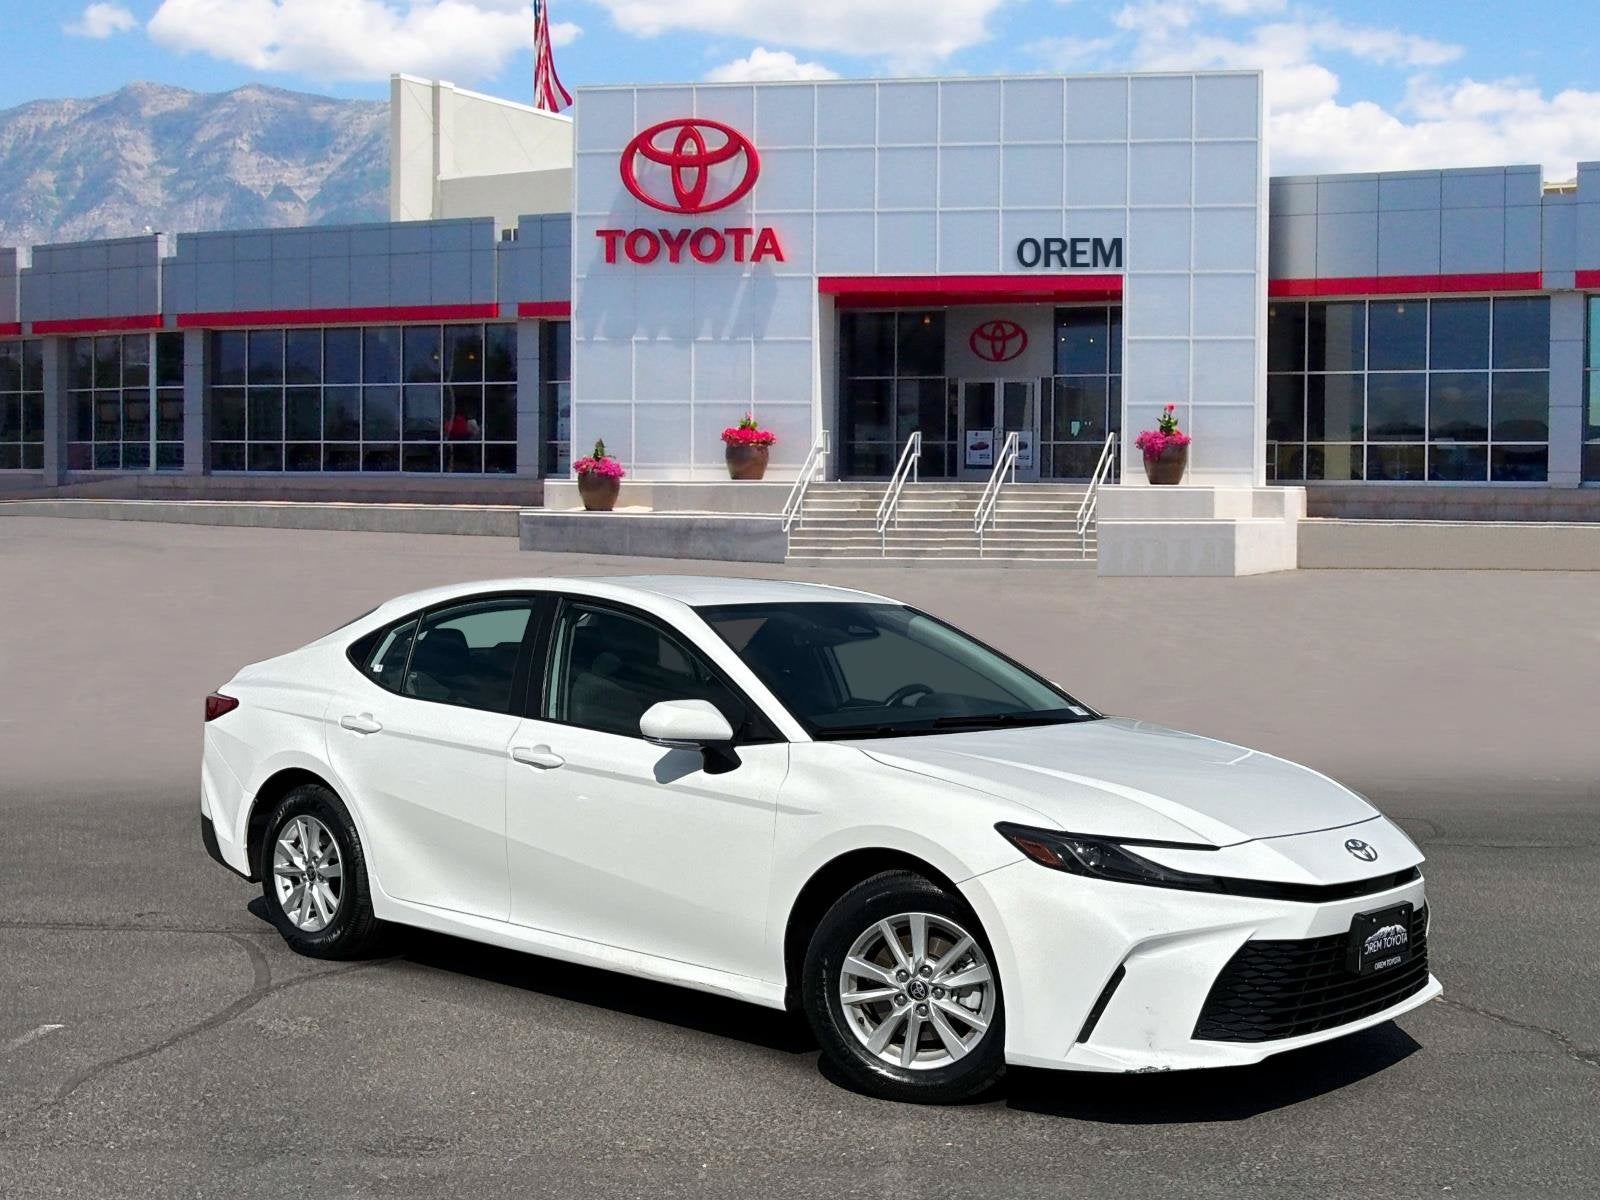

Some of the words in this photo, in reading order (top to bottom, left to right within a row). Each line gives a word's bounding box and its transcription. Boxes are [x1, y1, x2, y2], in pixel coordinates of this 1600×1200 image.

[596, 227, 784, 264] TOYOTA
[1017, 237, 1123, 268] OREM
[1383, 932, 1408, 949] TOYOTA
[1374, 960, 1386, 970] OREM
